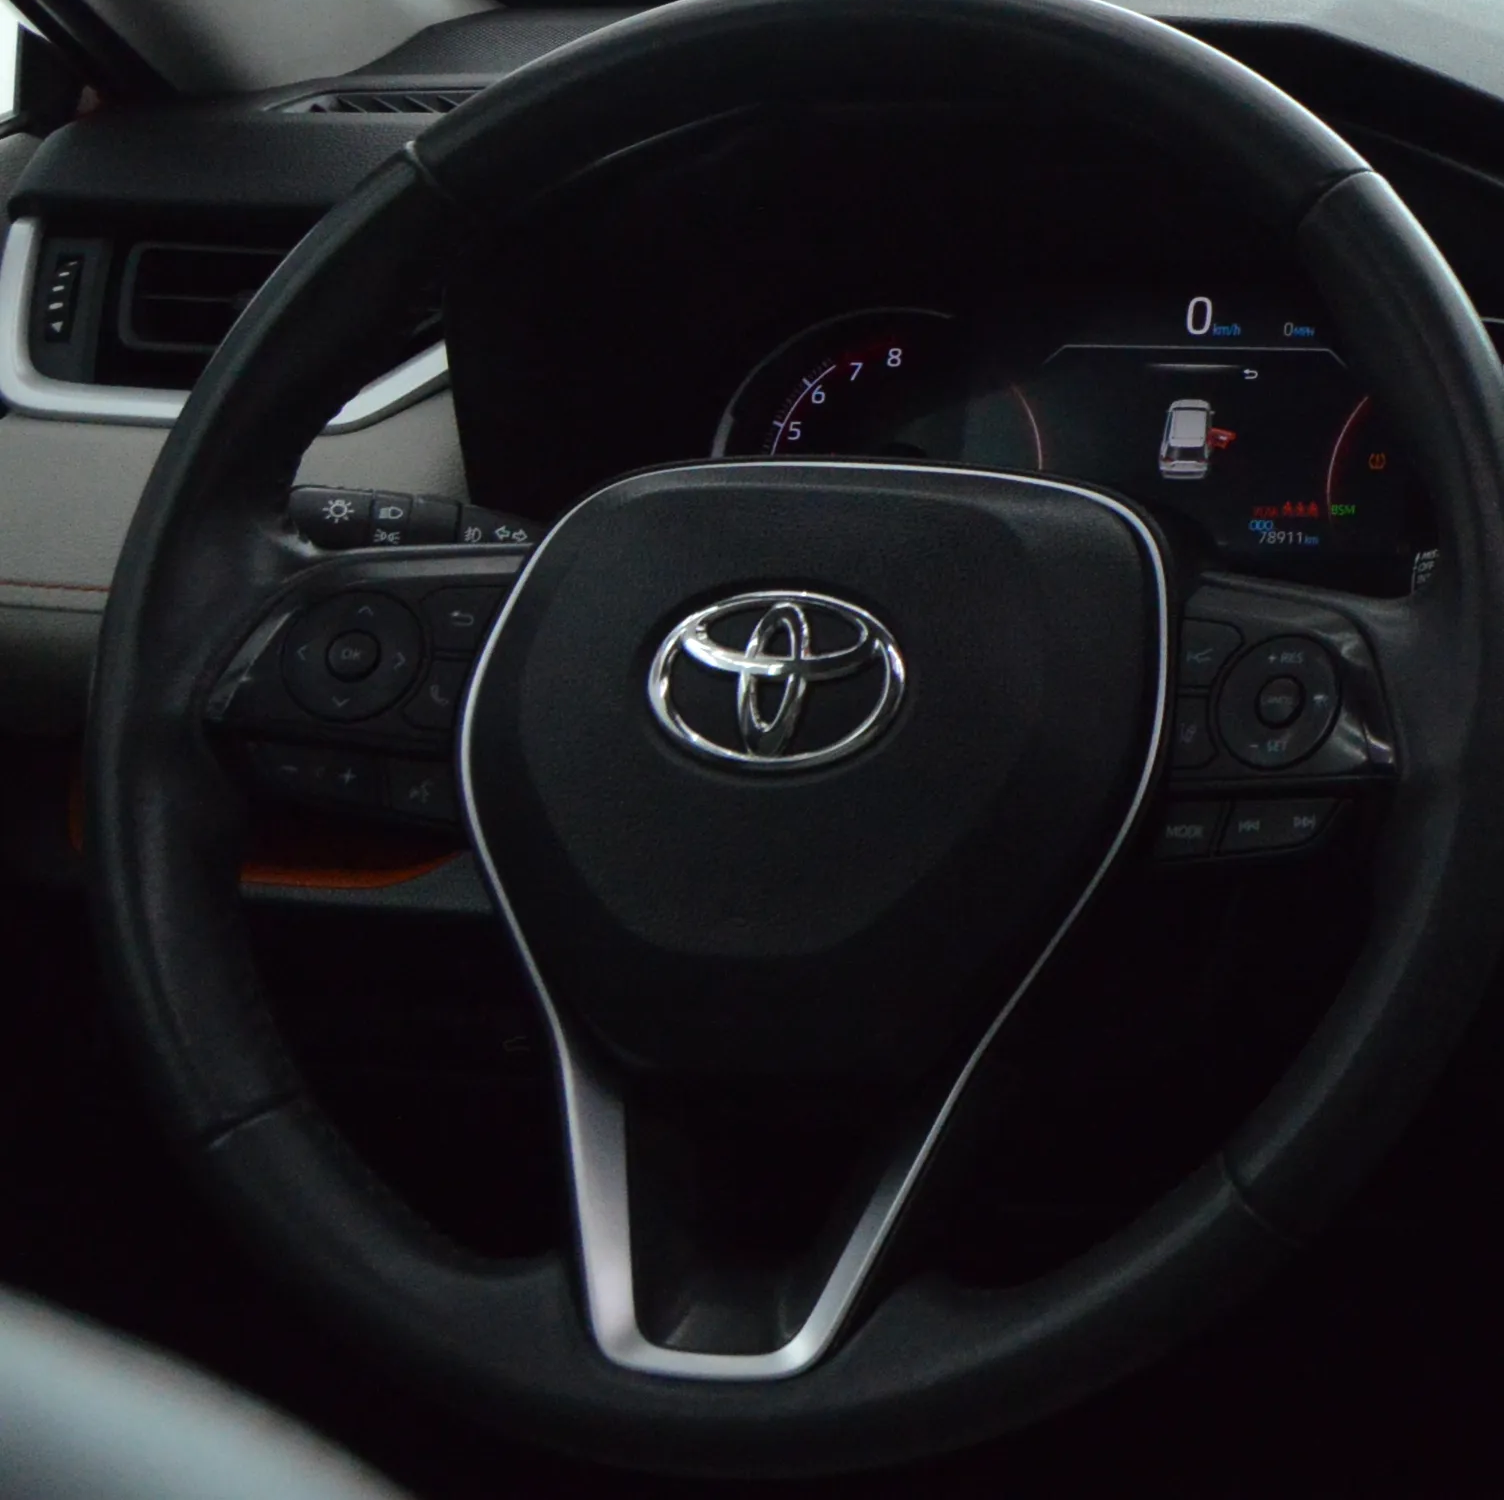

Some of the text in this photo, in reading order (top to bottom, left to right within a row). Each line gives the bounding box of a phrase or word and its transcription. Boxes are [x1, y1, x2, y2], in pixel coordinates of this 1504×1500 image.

[1185, 295, 1213, 336] 0
[886, 346, 903, 368] 8
[848, 361, 864, 382] 7
[810, 383, 826, 405] 6
[786, 420, 803, 441] 5
[1331, 504, 1356, 517] BSM
[1248, 519, 1274, 532] ODO
[1258, 530, 1320, 546] 78911 km
[339, 648, 362, 660] OK
[1165, 825, 1205, 839] MODE
